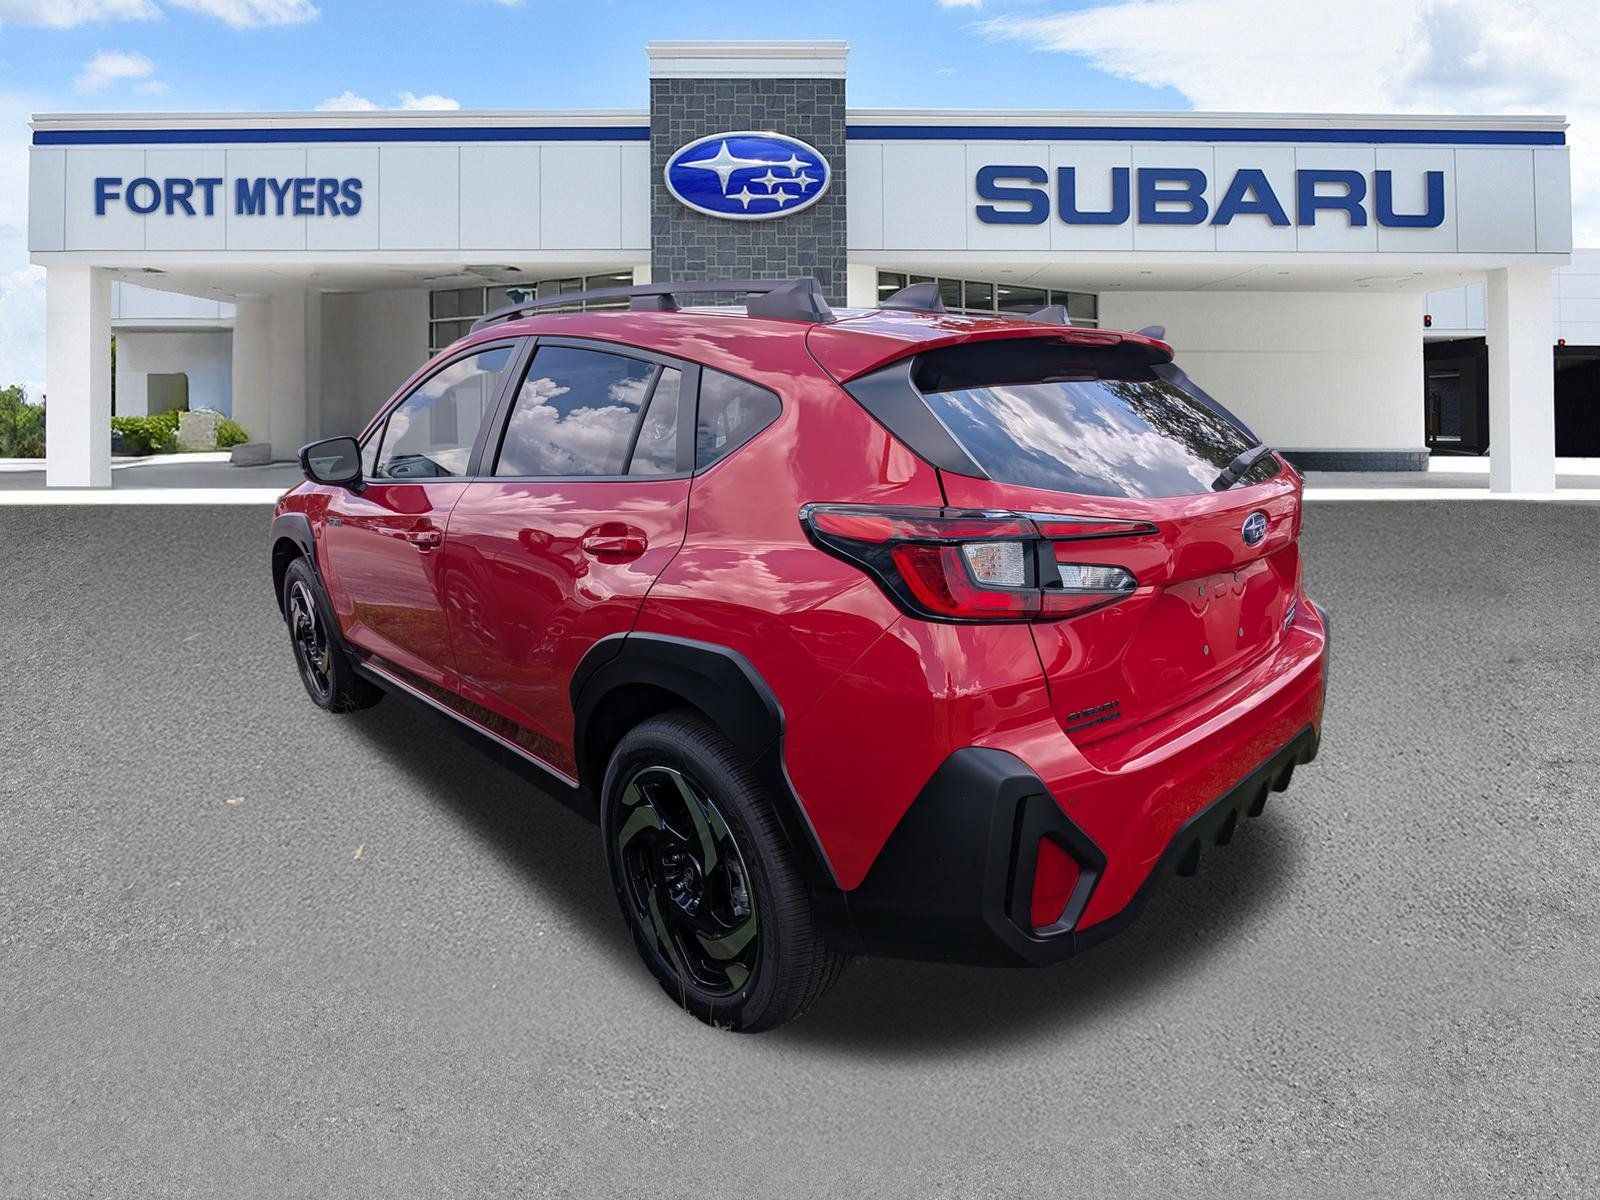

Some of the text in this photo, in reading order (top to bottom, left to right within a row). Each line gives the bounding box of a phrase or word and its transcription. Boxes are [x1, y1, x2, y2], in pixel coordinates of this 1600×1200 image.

[94, 176, 363, 217] FORT MYERS
[976, 164, 1446, 228] SUBARU
